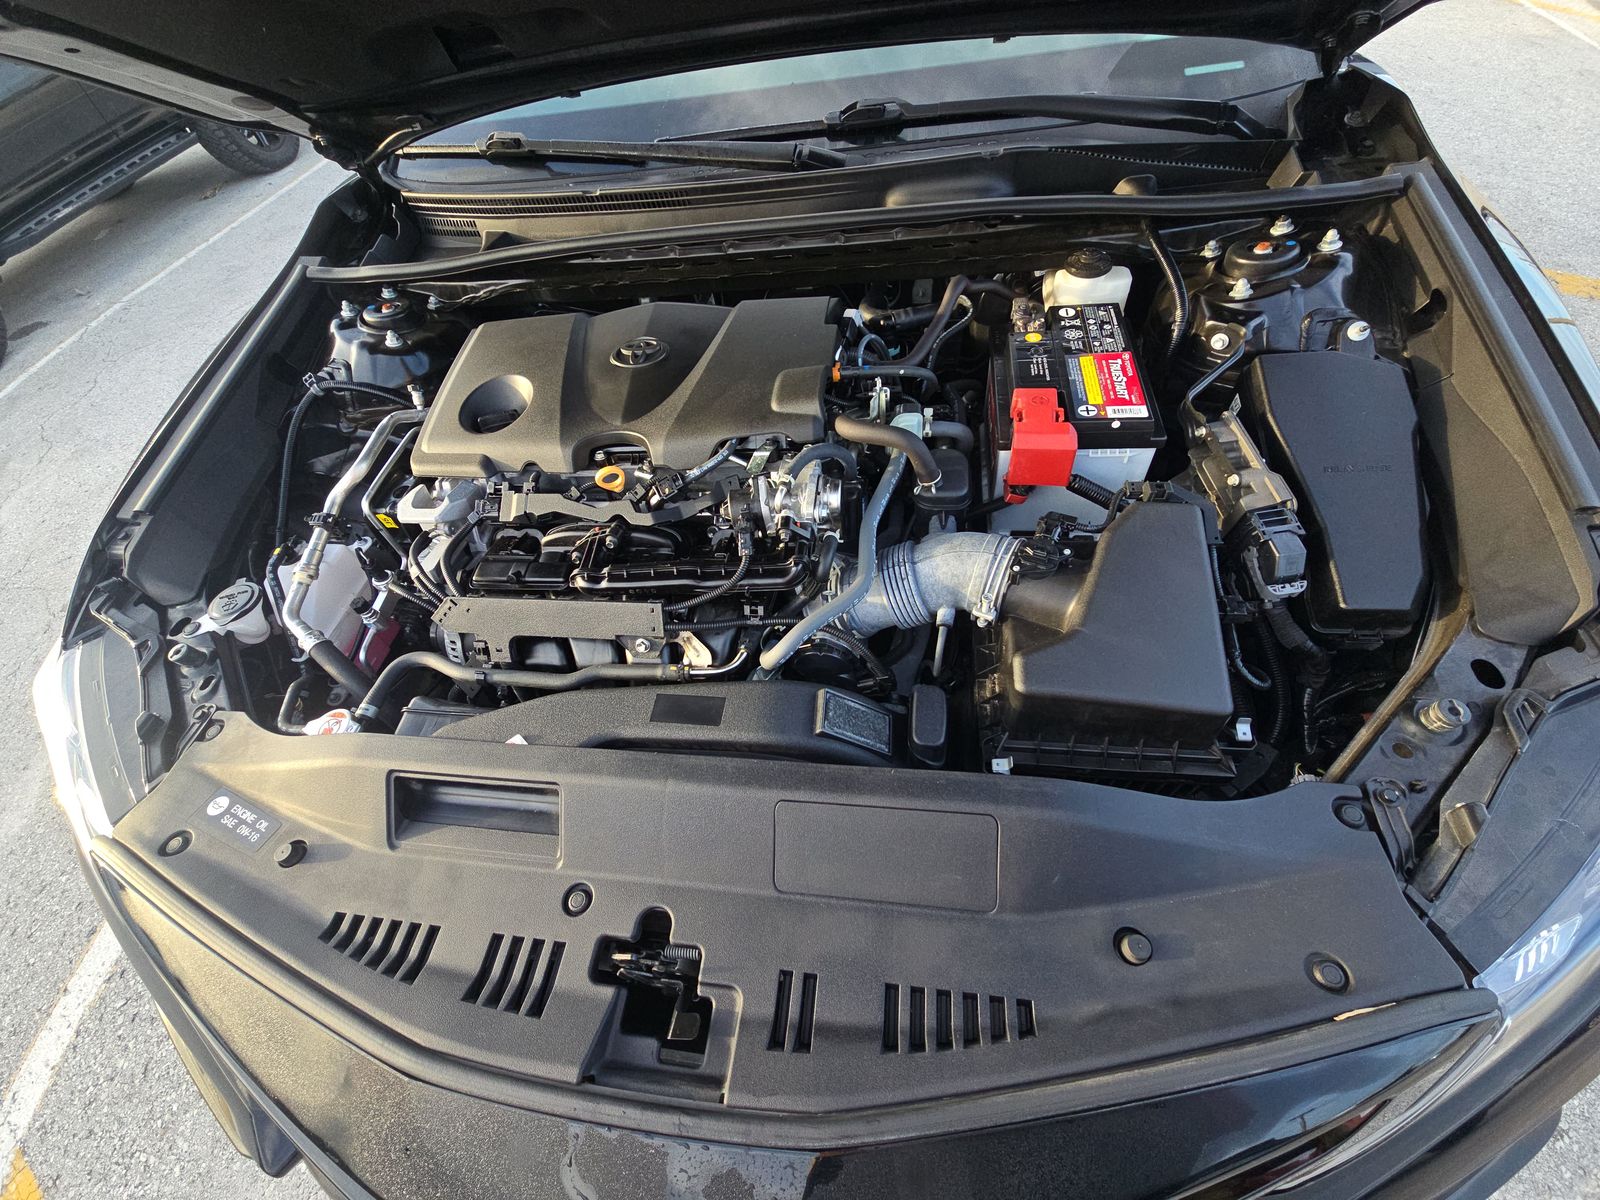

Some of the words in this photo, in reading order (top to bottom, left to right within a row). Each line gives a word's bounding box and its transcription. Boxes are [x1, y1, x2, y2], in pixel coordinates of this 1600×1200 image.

[1124, 360, 1133, 376] TOYOTA
[220, 814, 238, 828] SAE
[237, 824, 260, 842] 0W-16
[231, 804, 257, 824] ENGINE
[256, 820, 270, 832] OIL
